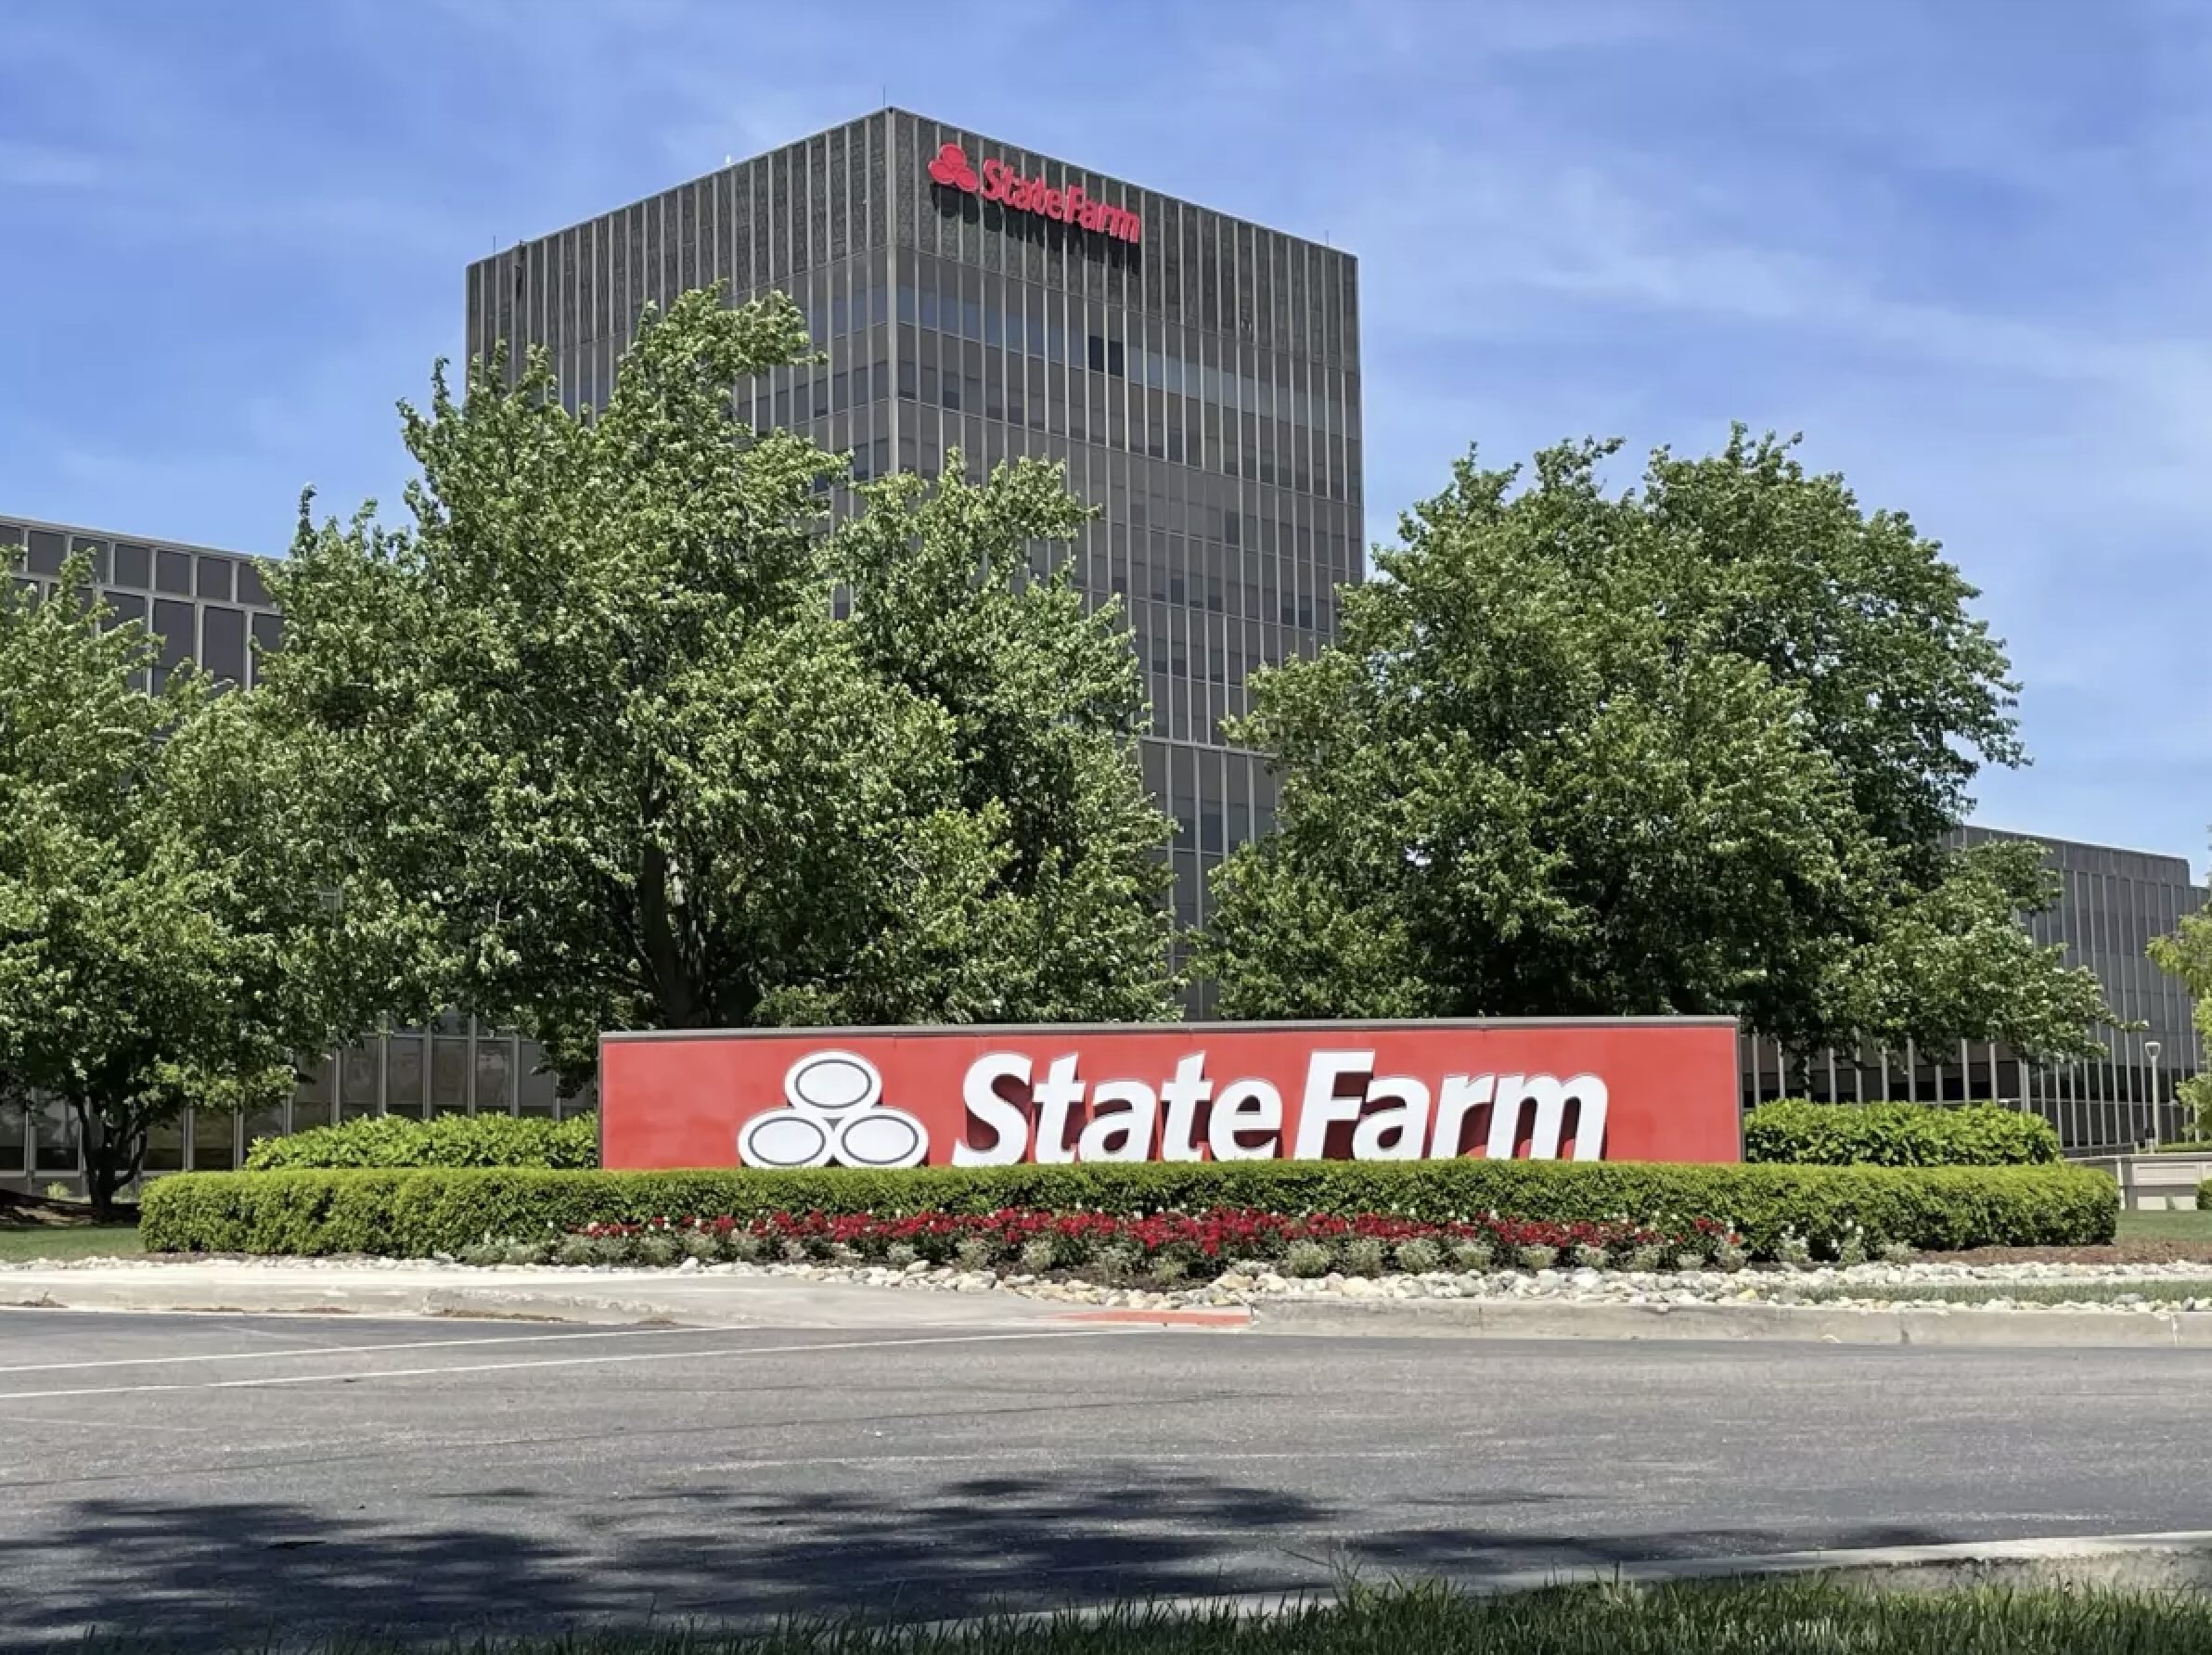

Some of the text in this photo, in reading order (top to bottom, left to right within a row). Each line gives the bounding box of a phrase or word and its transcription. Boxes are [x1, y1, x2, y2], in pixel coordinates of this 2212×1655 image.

[981, 159, 1140, 243] State Farm
[952, 1049, 1608, 1165] State Farm
